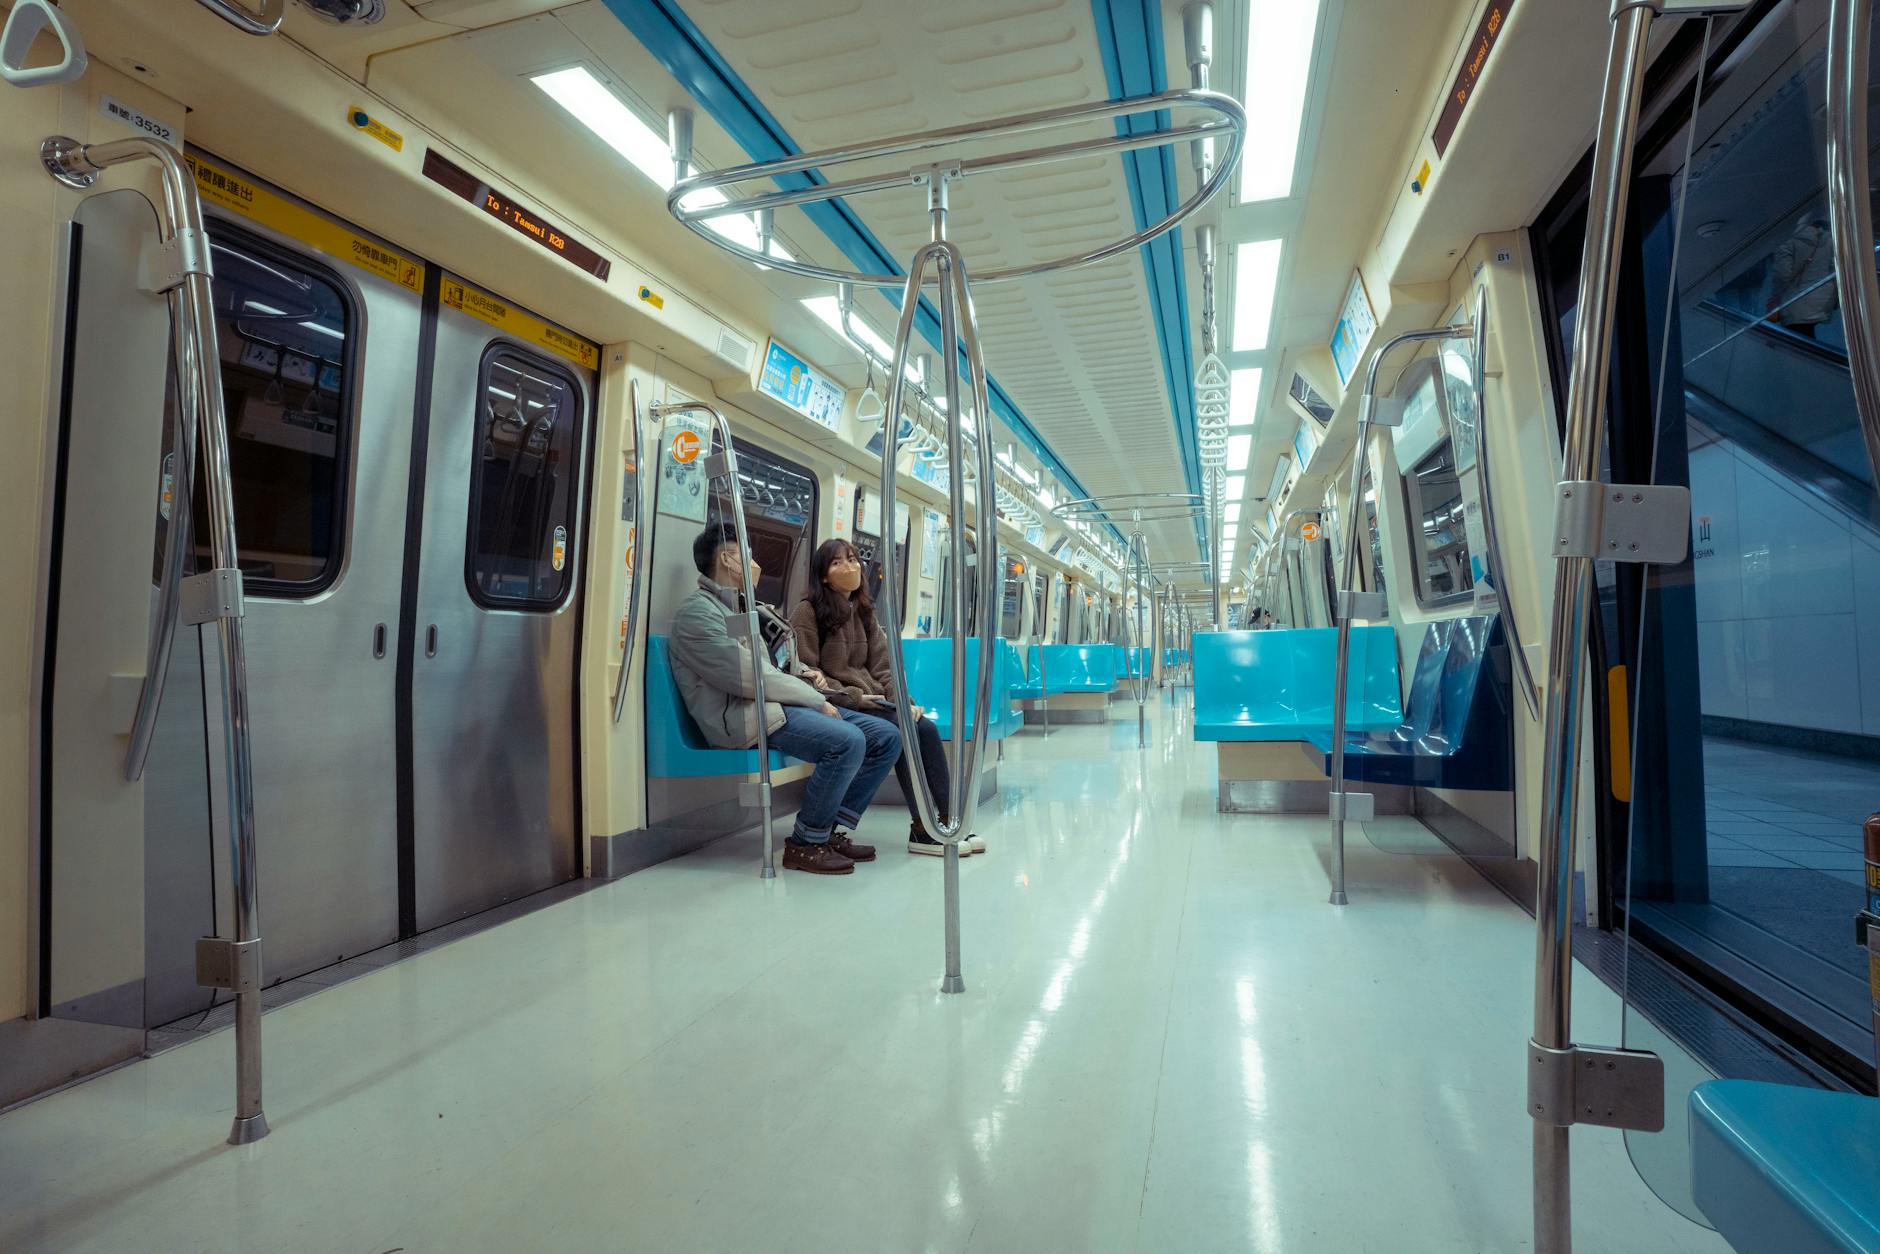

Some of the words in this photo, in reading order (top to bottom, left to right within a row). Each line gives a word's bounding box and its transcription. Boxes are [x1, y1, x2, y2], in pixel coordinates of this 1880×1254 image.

[1457, 89, 1467, 105] To
[1469, 35, 1489, 78] Tamsui
[1488, 9, 1501, 37] R28
[487, 194, 500, 211] To
[514, 211, 546, 239] Tamsui
